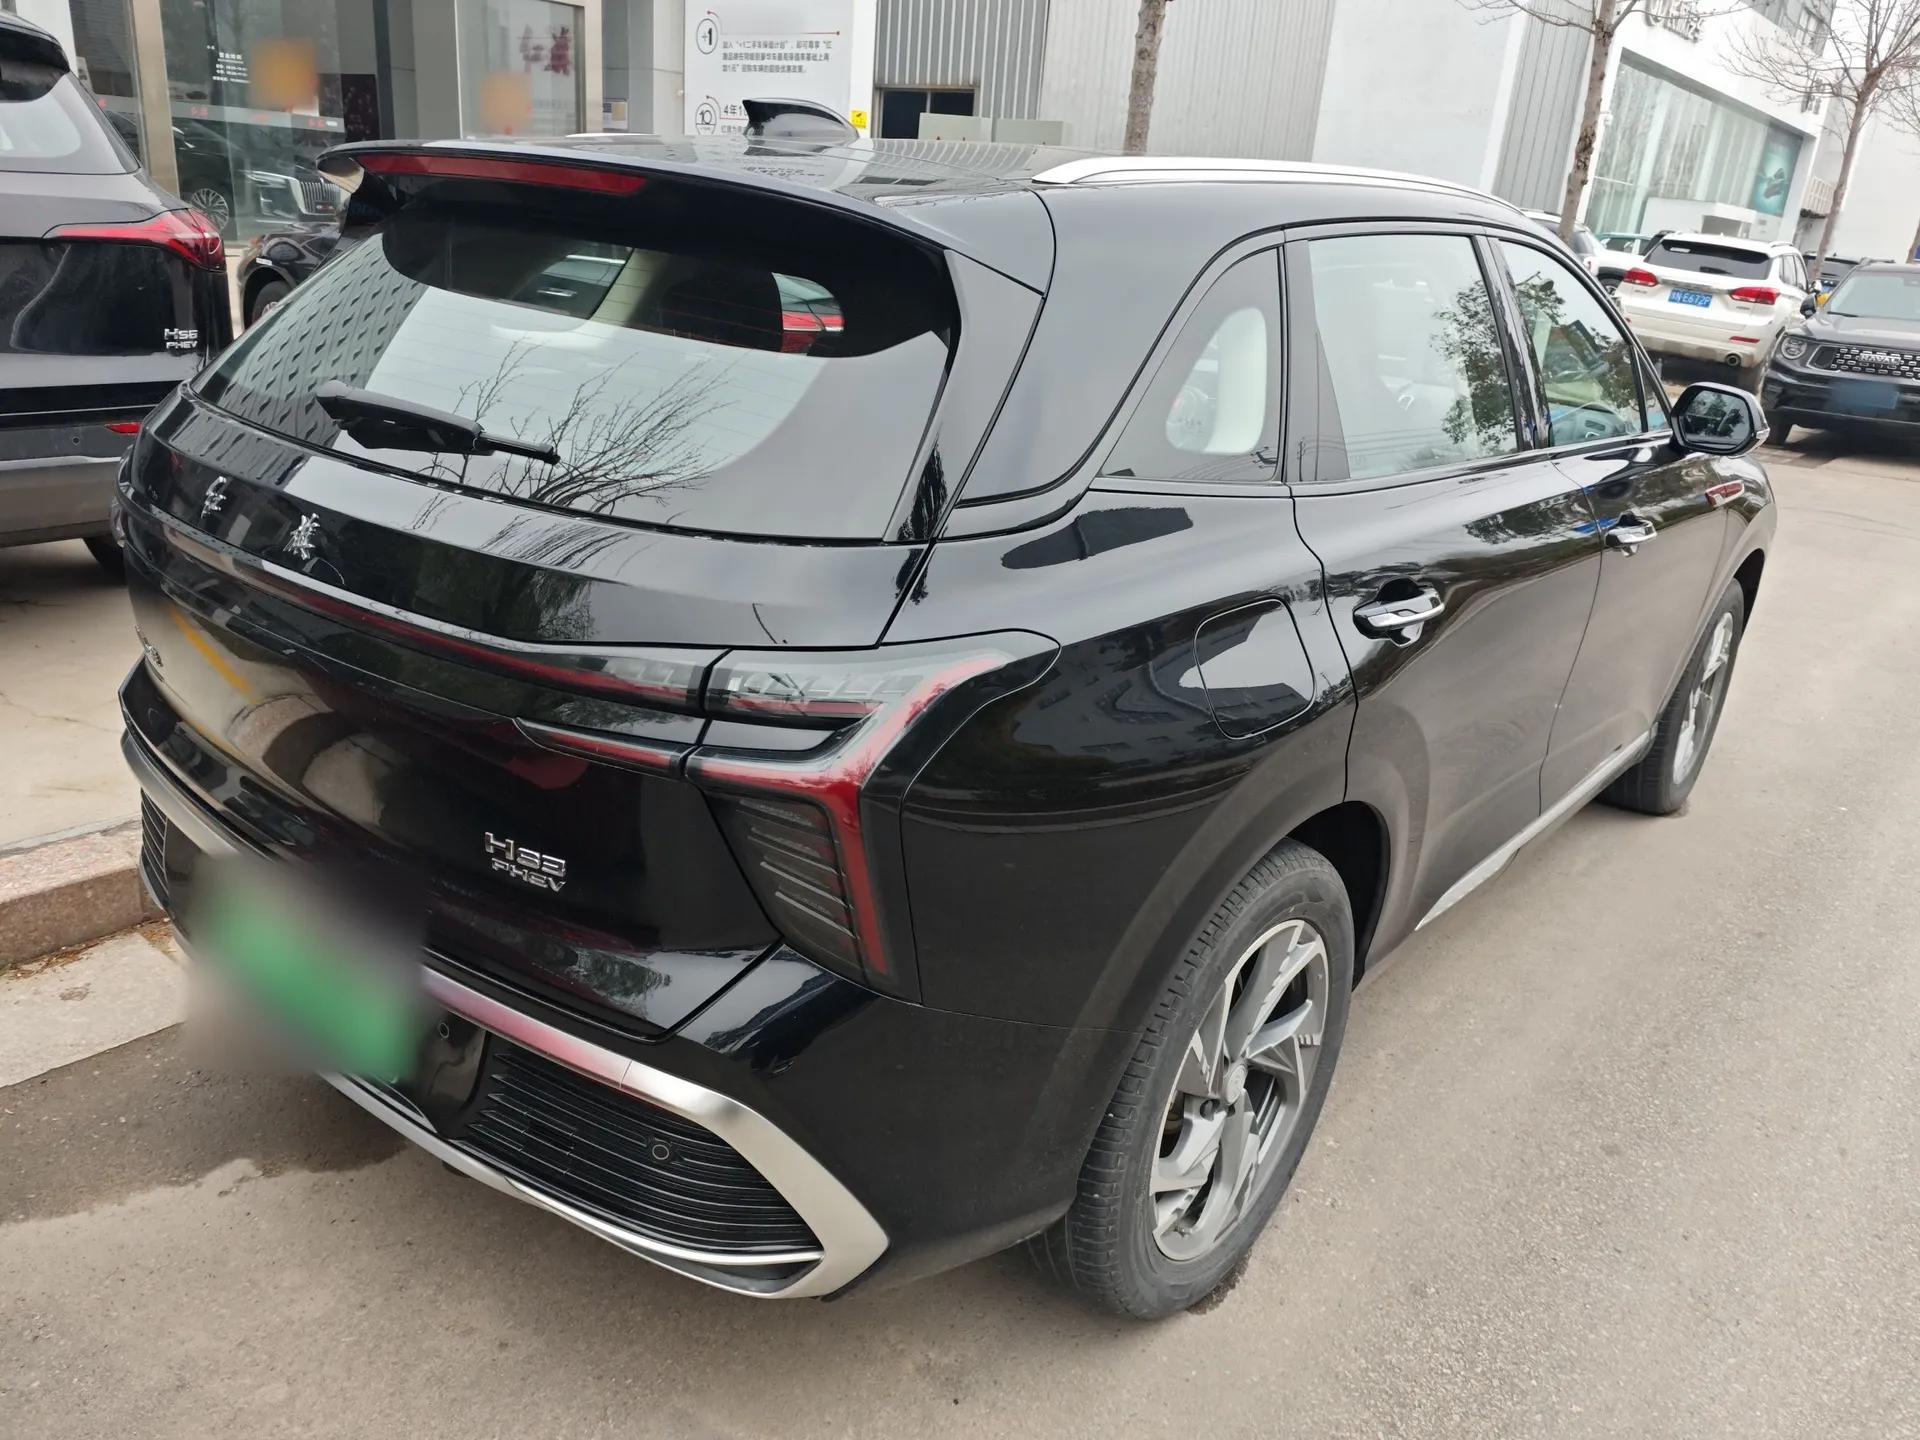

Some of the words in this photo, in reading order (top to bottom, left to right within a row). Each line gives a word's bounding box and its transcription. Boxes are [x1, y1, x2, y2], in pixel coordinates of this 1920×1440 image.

[699, 109, 713, 125] 10
[164, 328, 199, 340] HS6
[166, 340, 198, 349] PHEV
[491, 857, 567, 893] PHEV
